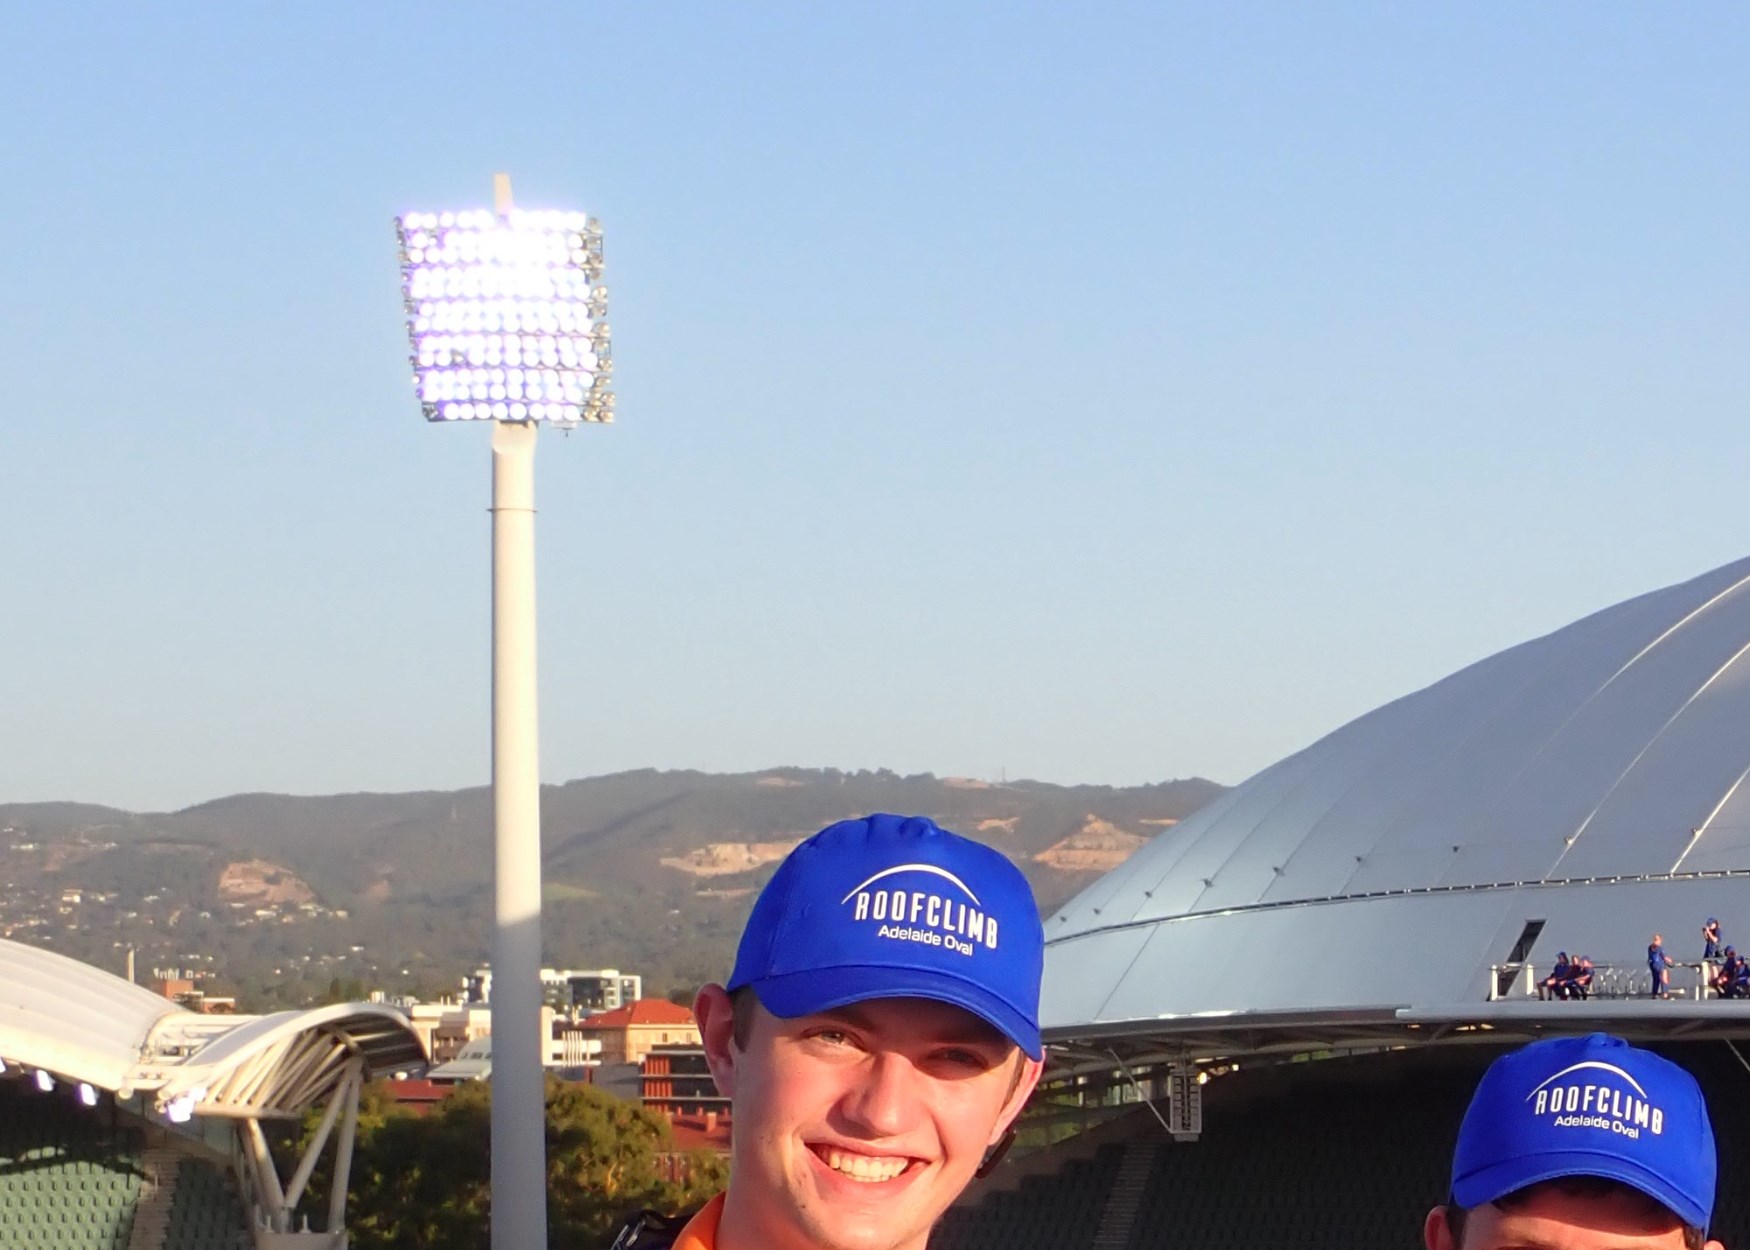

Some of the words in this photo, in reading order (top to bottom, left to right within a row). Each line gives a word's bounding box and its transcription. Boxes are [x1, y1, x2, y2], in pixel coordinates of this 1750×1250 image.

[855, 890, 998, 949] ROOFCLIMB
[878, 924, 942, 946] Adelaide
[944, 935, 973, 957] Oval
[1535, 1085, 1664, 1135] ROOFCLIMB
[1554, 1114, 1610, 1130] Adelaide
[1612, 1121, 1639, 1139] Oval
